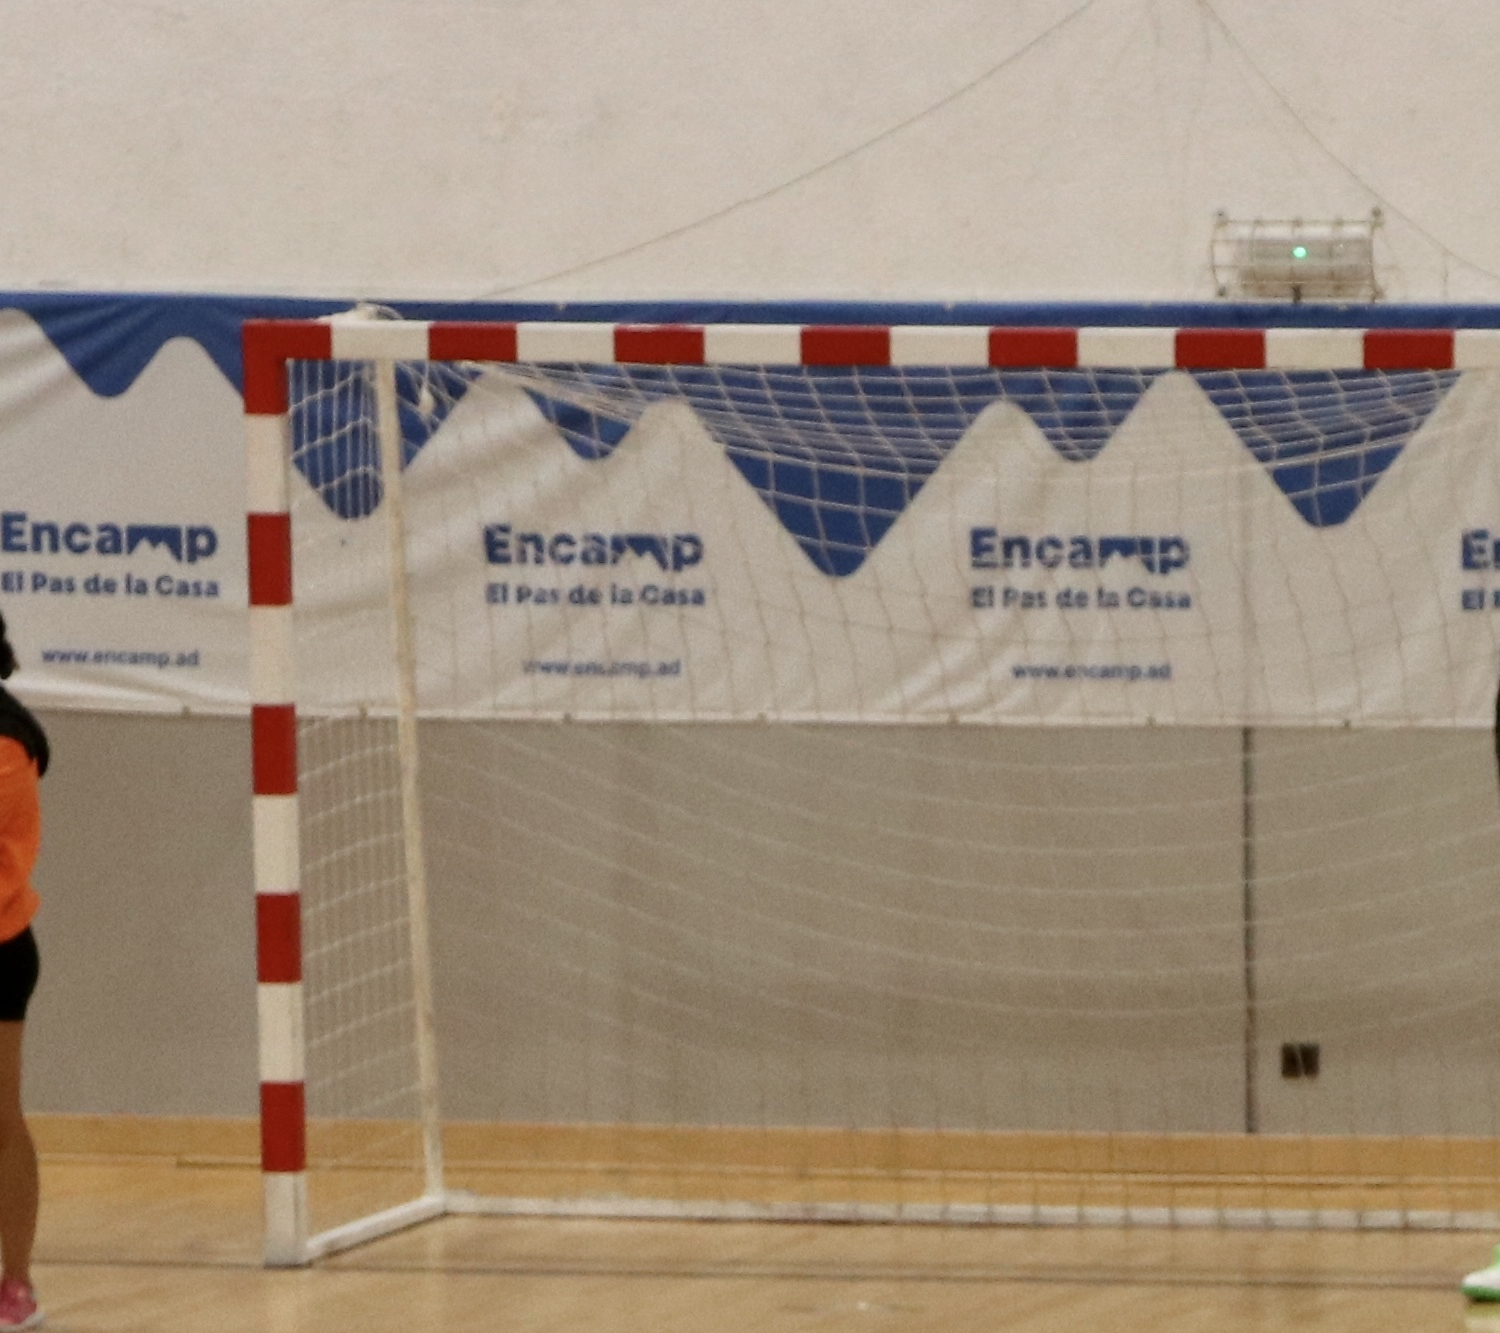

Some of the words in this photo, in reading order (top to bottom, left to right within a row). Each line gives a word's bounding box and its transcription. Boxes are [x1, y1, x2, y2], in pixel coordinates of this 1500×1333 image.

[0, 512, 218, 564] Encamp
[483, 524, 703, 572] Encamp
[970, 527, 1188, 575] Encamp
[1, 571, 24, 593] El
[31, 571, 76, 594] Pas
[83, 575, 118, 595] de
[124, 574, 149, 596] la
[154, 574, 220, 598] Casa
[486, 583, 509, 604] El
[515, 585, 561, 606] Pas
[567, 585, 601, 606] de
[610, 584, 634, 606] la
[640, 584, 706, 606] Casa
[971, 586, 994, 609] El
[1002, 586, 1047, 609] Pas
[1055, 587, 1089, 609] de
[1096, 587, 1120, 609] la
[1126, 586, 1192, 609] Casa
[1461, 590, 1485, 611] El
[41, 649, 200, 669] www.encamp.ad
[1012, 664, 1172, 681] www.encamp.ad
